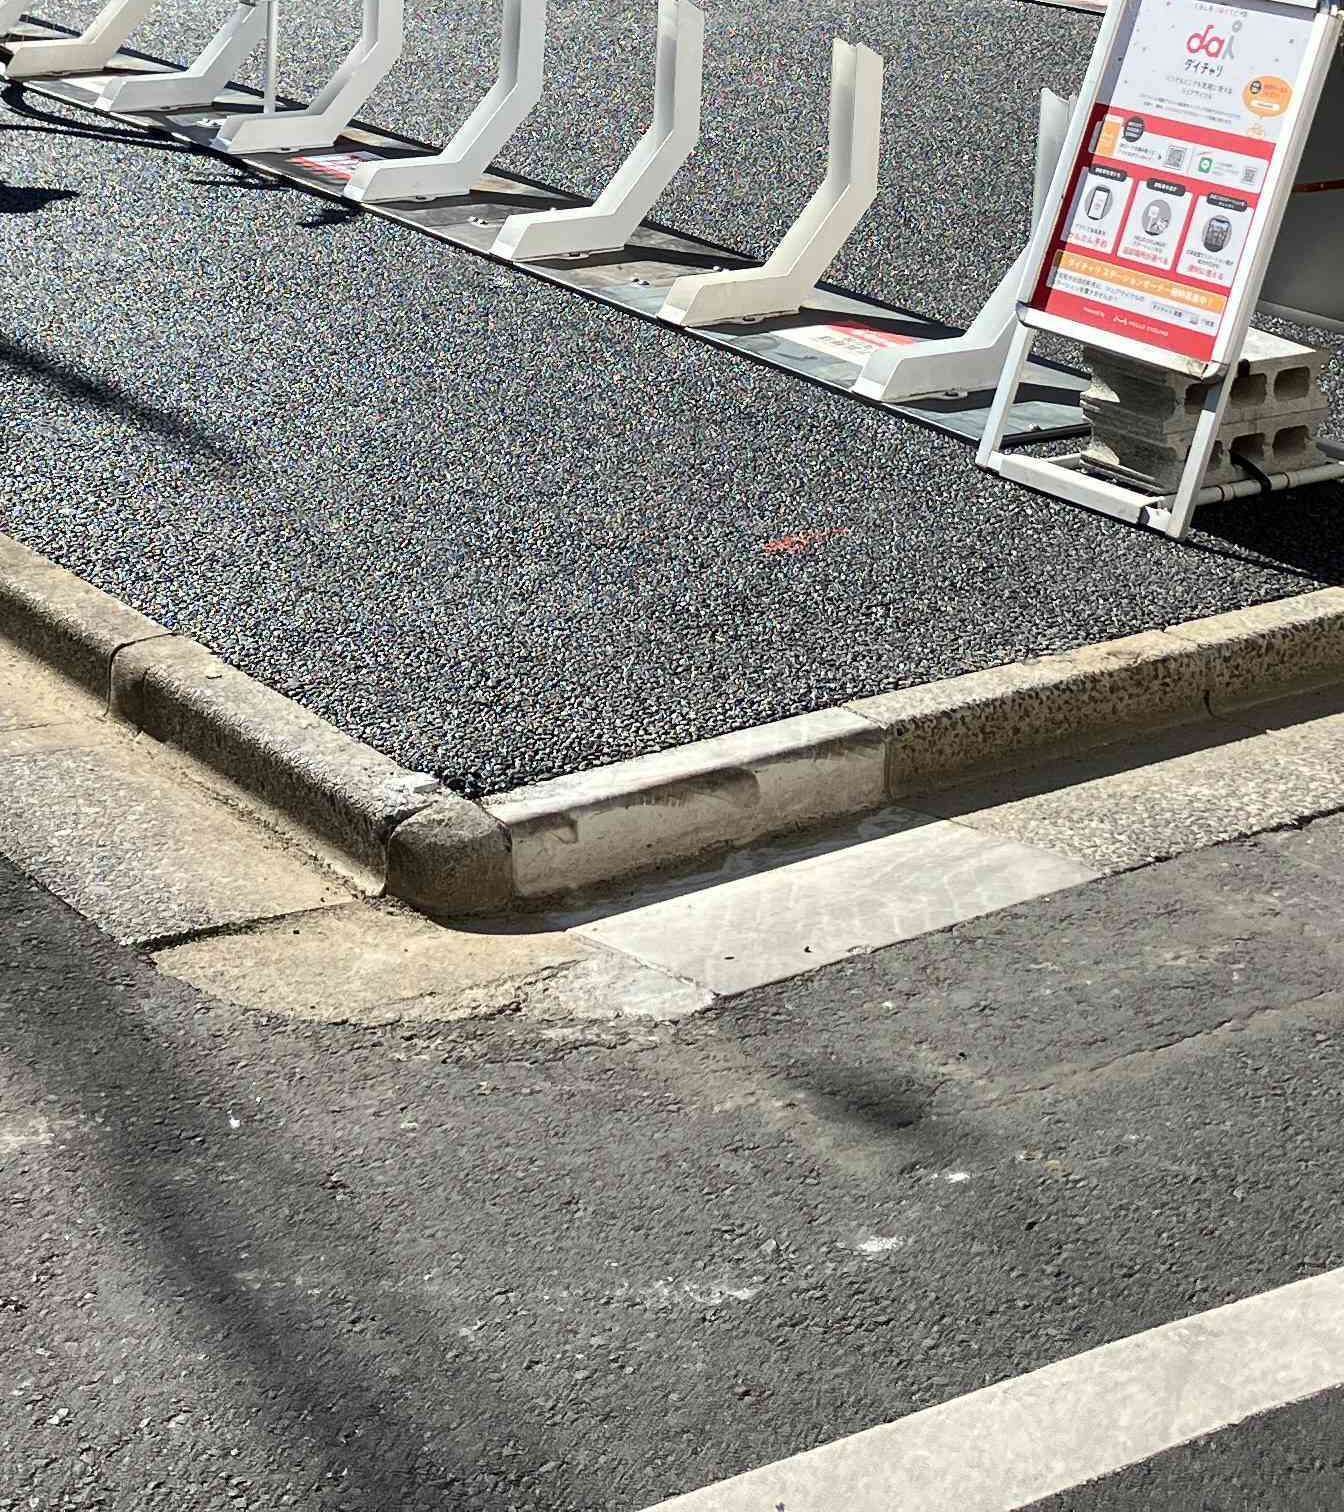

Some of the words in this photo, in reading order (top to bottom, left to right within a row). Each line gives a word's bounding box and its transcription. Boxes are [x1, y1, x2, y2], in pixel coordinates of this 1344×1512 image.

[1186, 20, 1242, 59] dai
[1184, 58, 1224, 78] ダイチャリ
